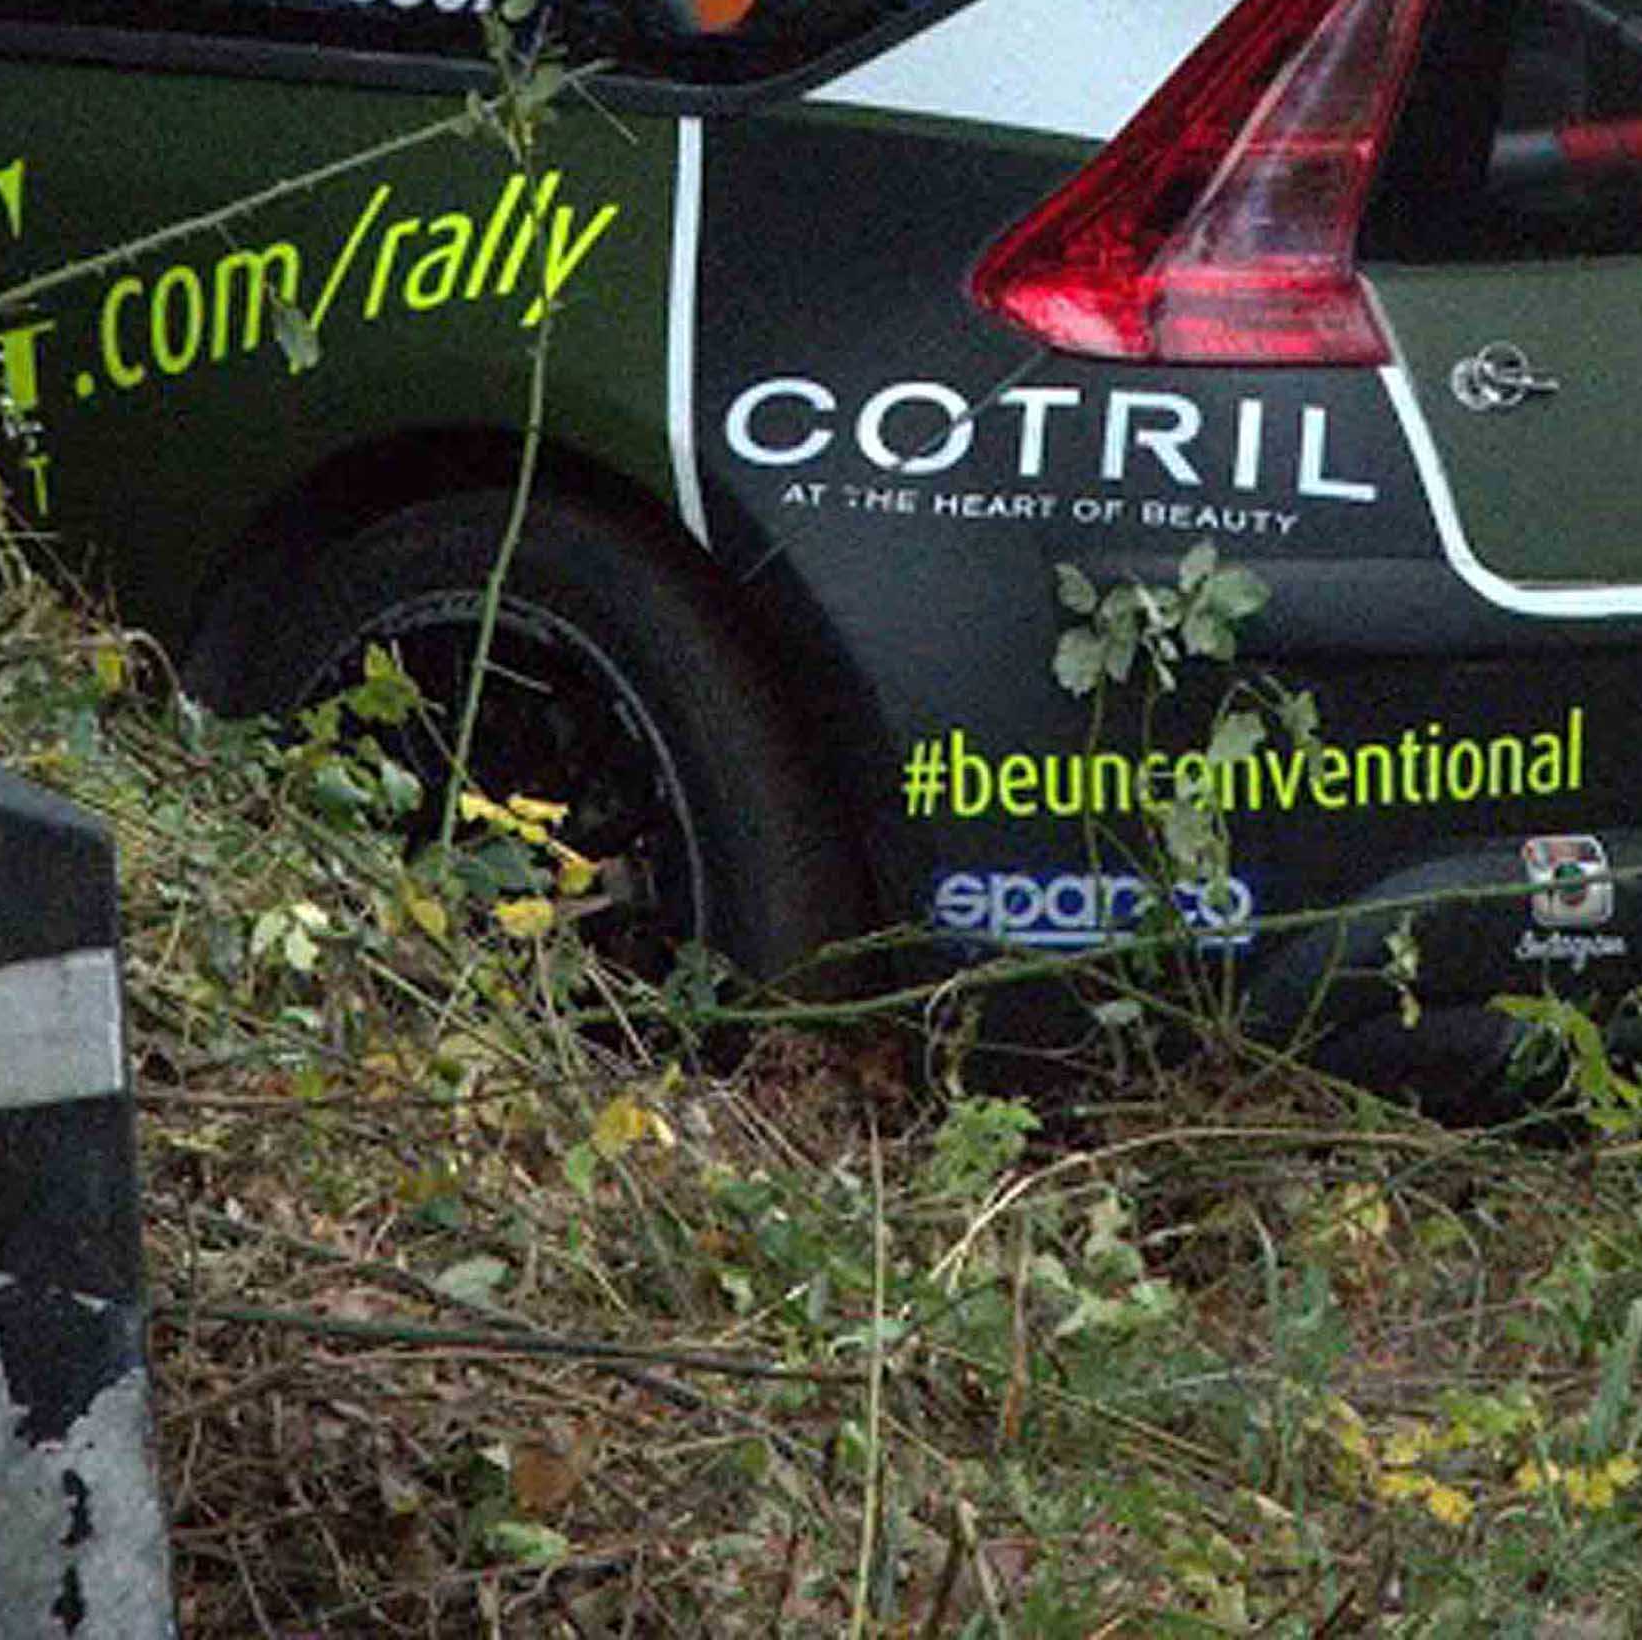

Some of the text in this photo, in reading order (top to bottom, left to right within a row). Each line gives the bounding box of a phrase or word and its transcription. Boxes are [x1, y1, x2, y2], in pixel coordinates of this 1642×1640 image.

[725, 377, 1378, 504] COTRIL
[780, 482, 1300, 536] AT THE HEART OF BEAUTY
[901, 707, 1584, 818] #beunconventional
[934, 872, 1254, 950] sparco
